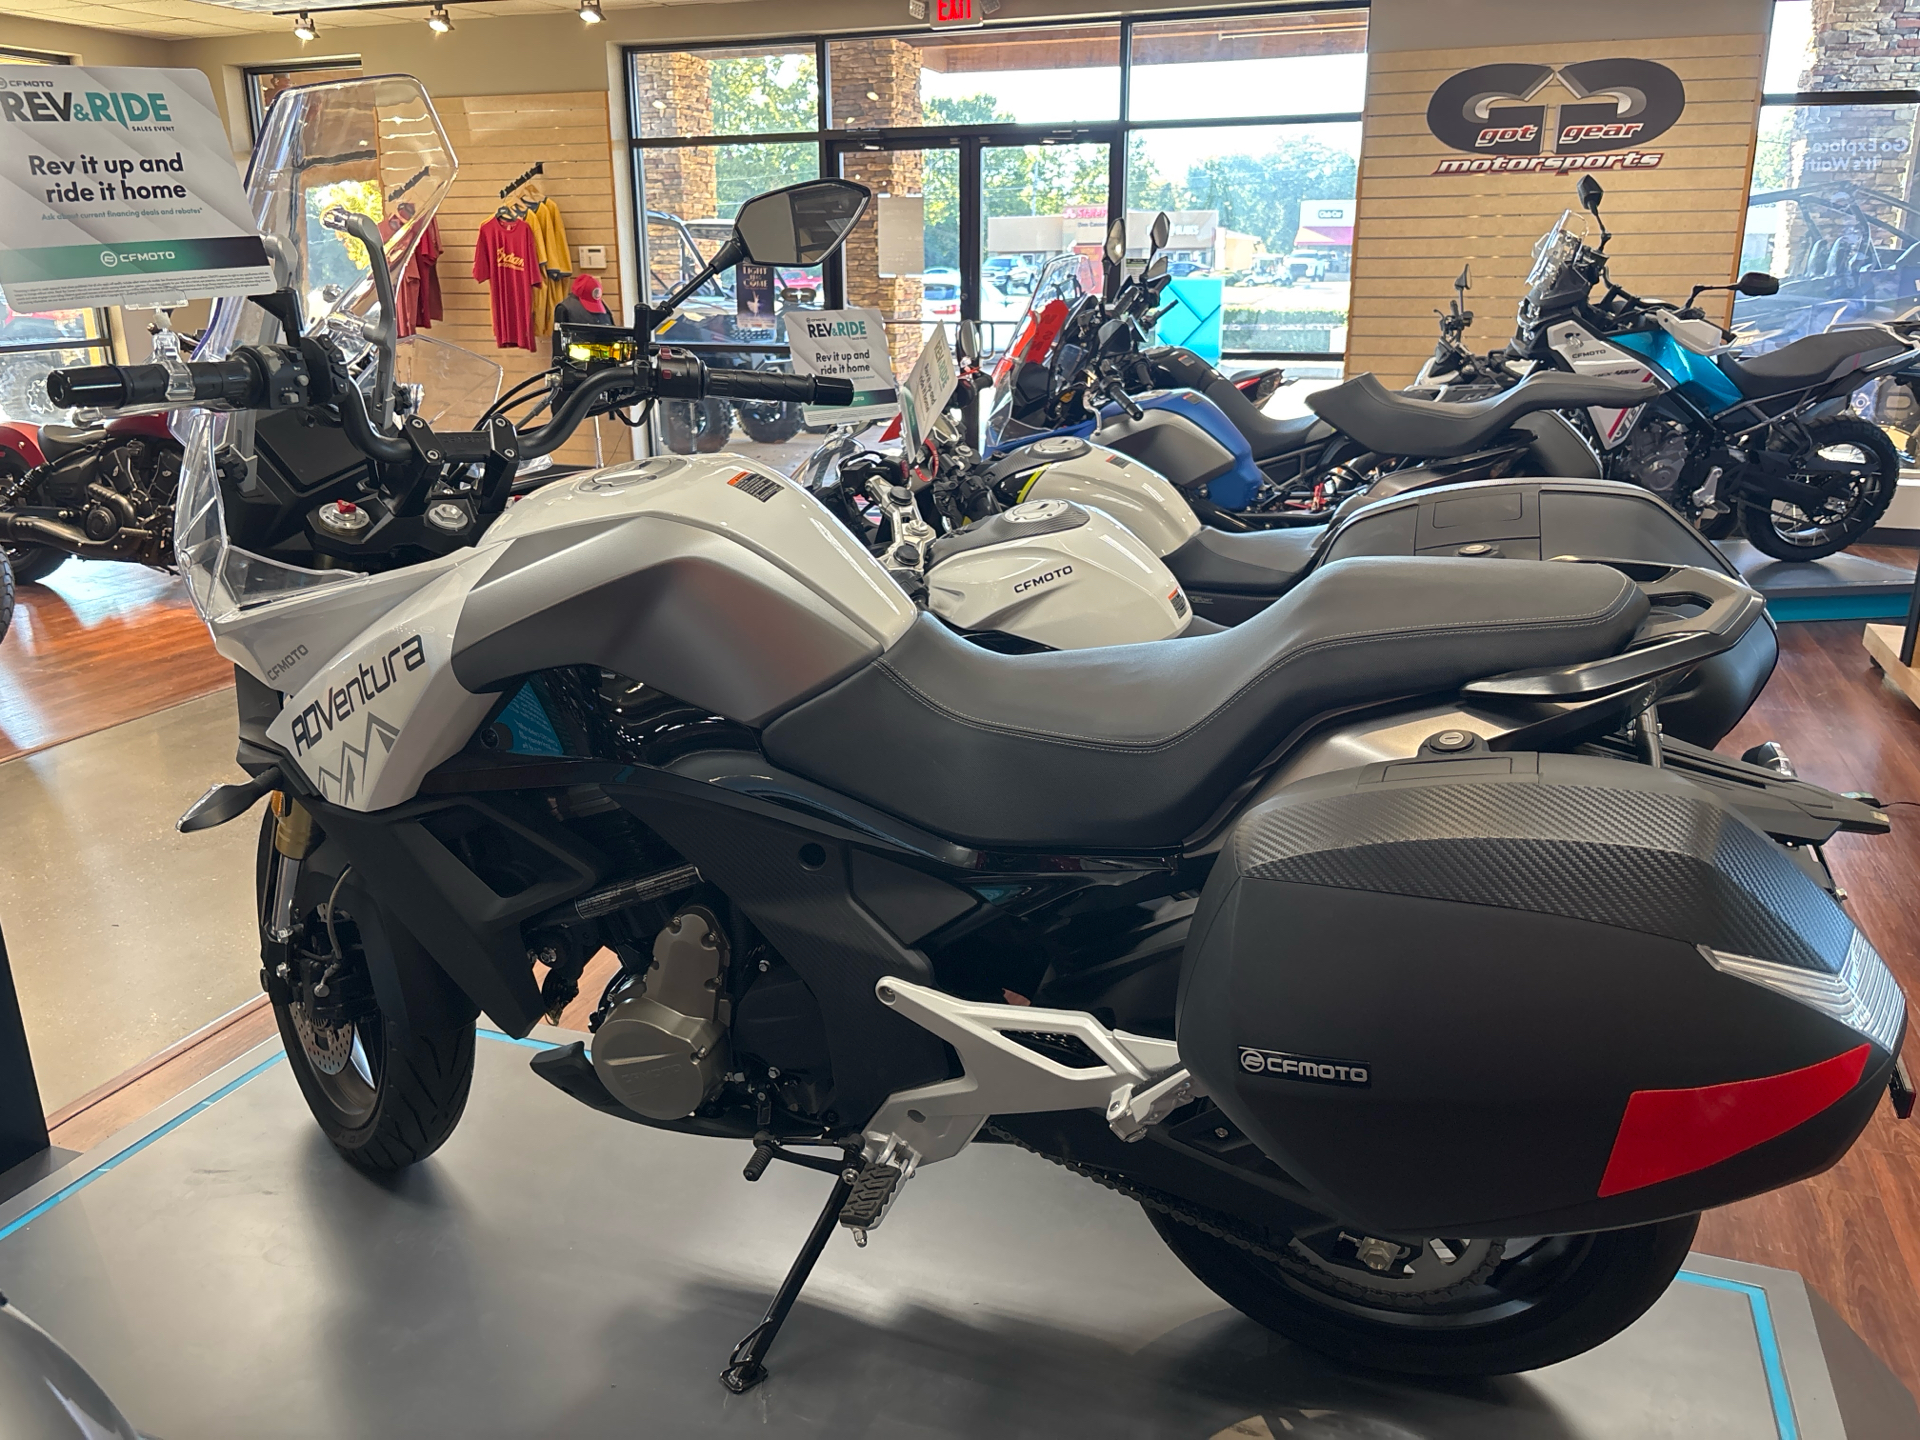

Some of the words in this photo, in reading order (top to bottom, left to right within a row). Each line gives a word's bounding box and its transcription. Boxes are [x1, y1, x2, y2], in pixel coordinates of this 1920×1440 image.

[937, 0, 971, 21] EXIT
[9, 80, 54, 88] CFMOTO
[0, 92, 172, 130] REV&RIDE
[1475, 125, 1538, 147] got
[1559, 123, 1644, 144] gear
[28, 155, 74, 176] Rev
[80, 154, 99, 174] it
[105, 158, 134, 179] up
[140, 152, 184, 172] and
[1432, 151, 1663, 175] motorsports
[46, 181, 94, 203] ride
[98, 181, 116, 201] it
[122, 179, 187, 200] home
[42, 212, 55, 220] Ask
[57, 211, 79, 220] about
[80, 211, 106, 219] current
[107, 209, 140, 218] financing
[141, 208, 160, 216] deals
[120, 250, 176, 263] CFMOTO
[808, 321, 867, 340] REV&RIDE
[816, 352, 832, 362] Rev
[833, 352, 841, 362] it
[842, 354, 852, 364] up
[854, 349, 870, 360] and
[1572, 350, 1606, 358] CFMOTO
[820, 364, 837, 375] ride
[838, 364, 846, 374] it
[847, 362, 870, 374] home
[1014, 565, 1073, 594] CFMOTO
[266, 644, 309, 681] CFMOTO
[1266, 1057, 1368, 1082] CFMOTO
